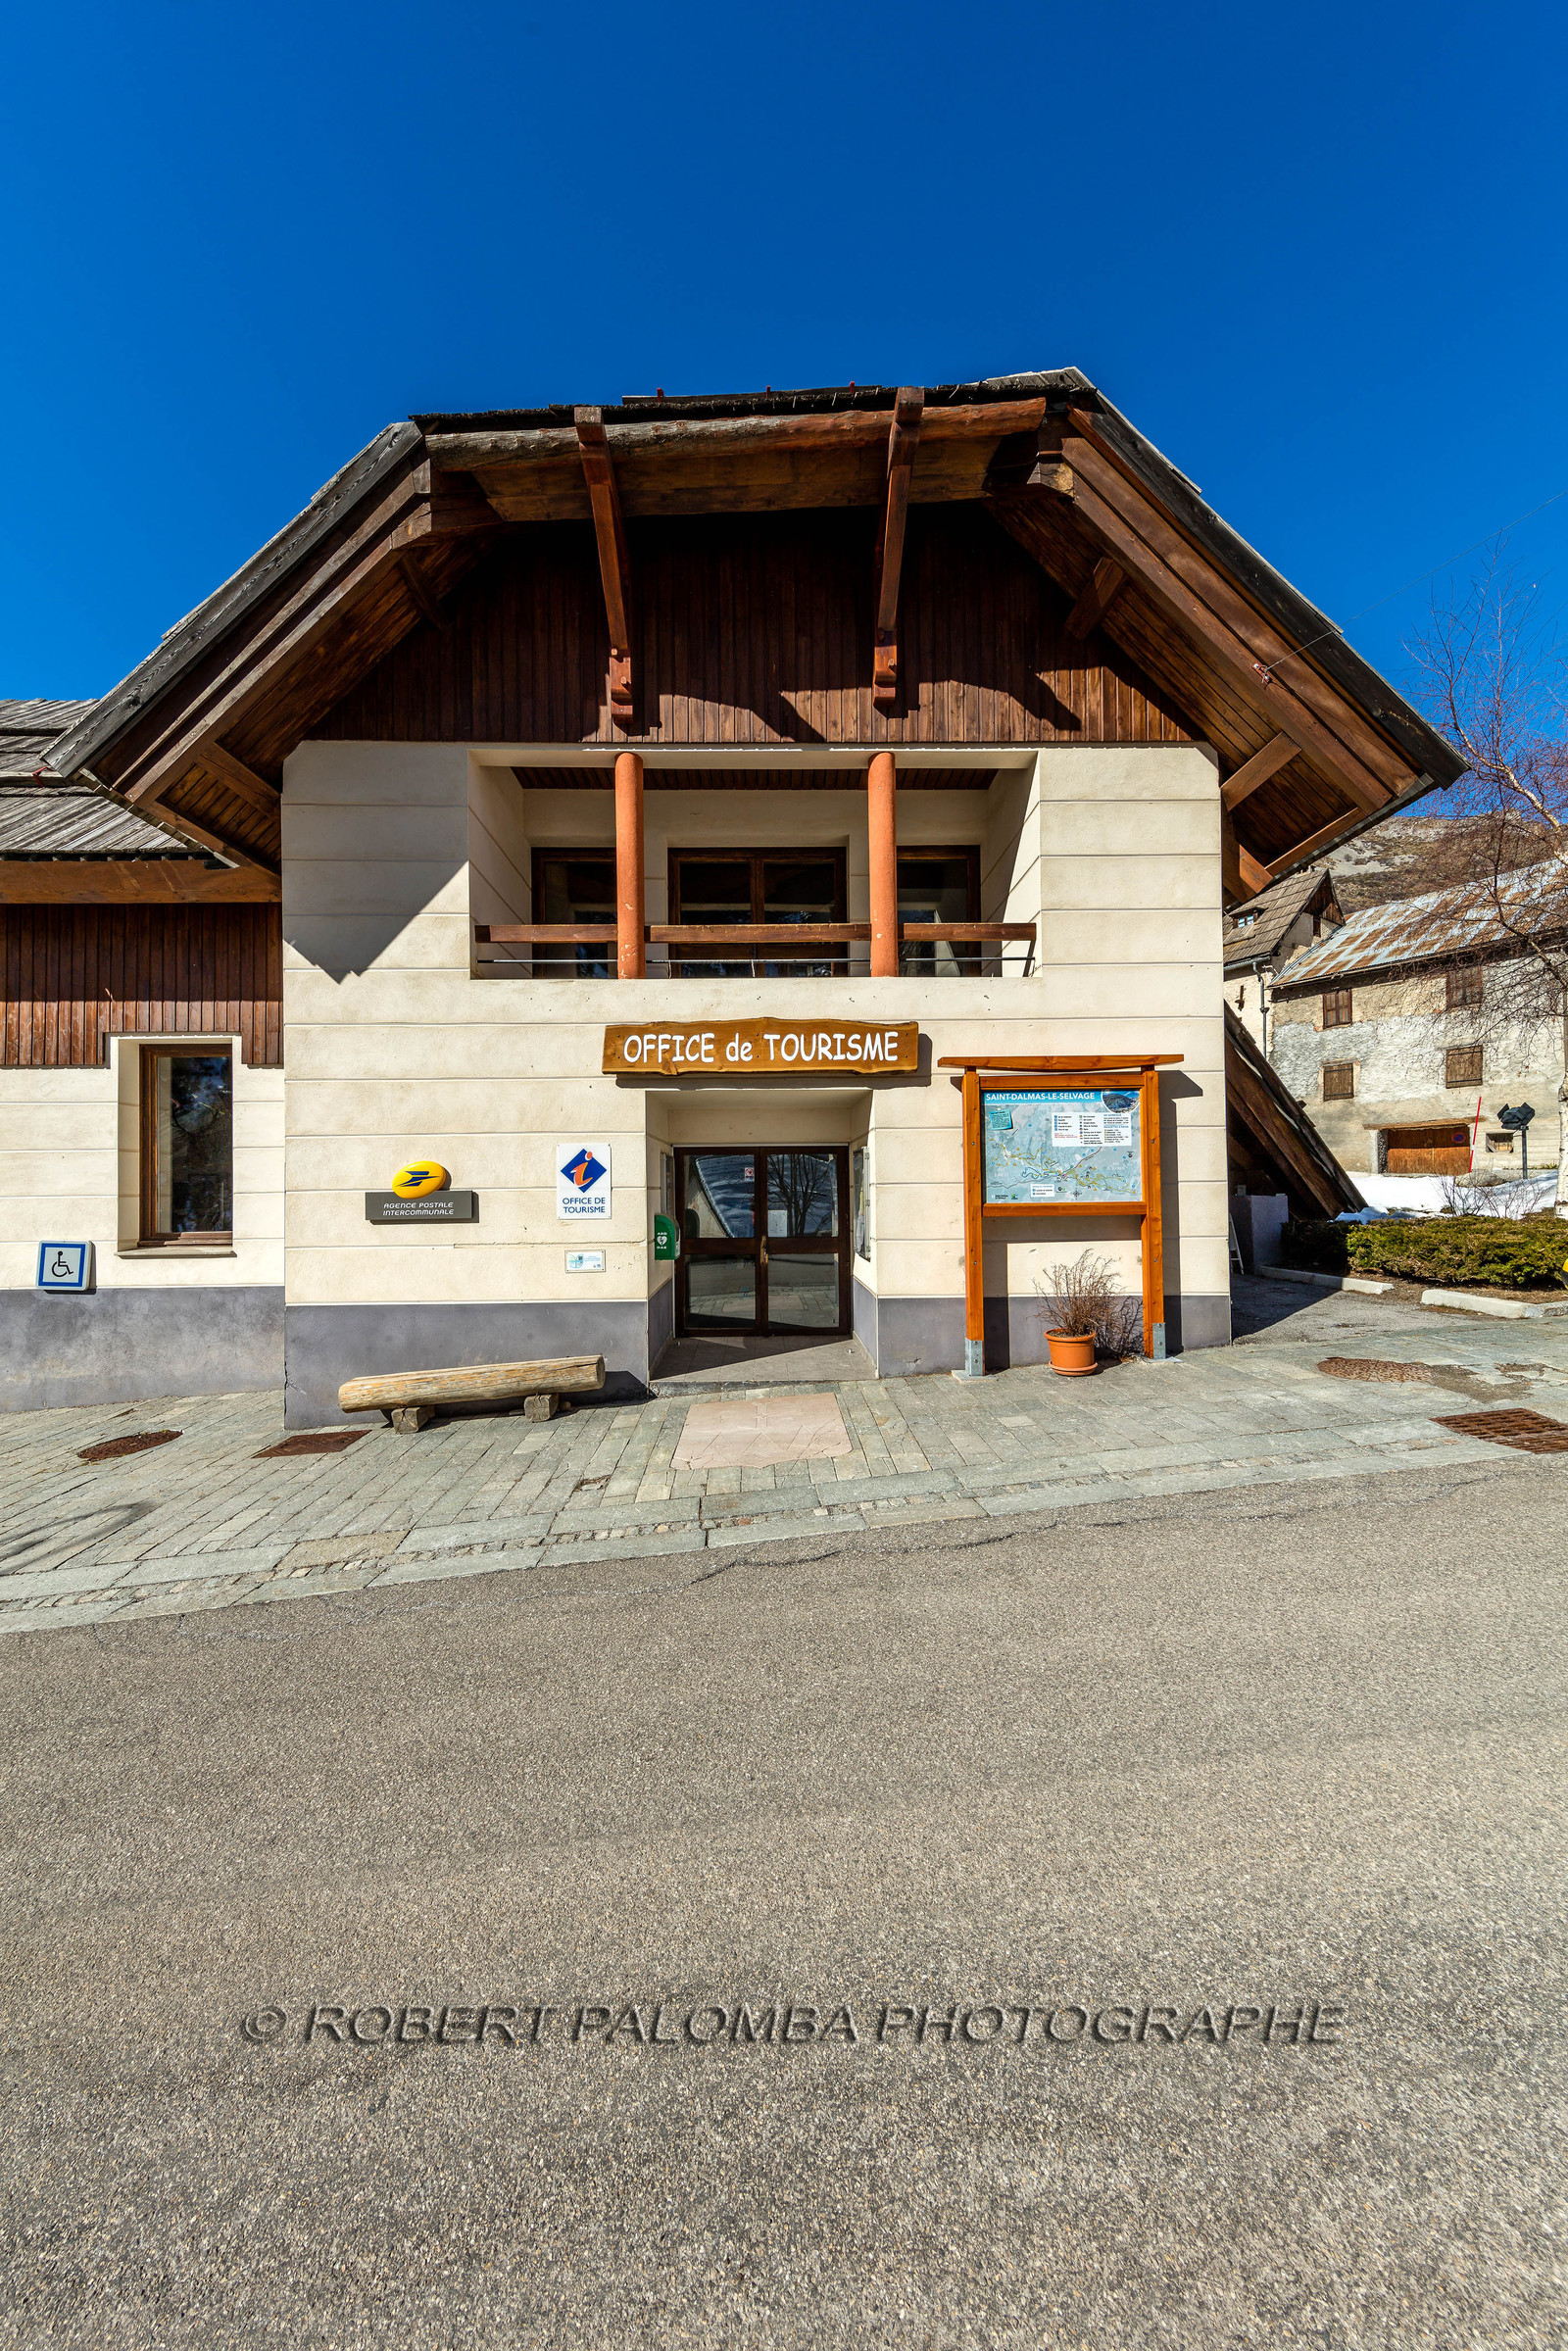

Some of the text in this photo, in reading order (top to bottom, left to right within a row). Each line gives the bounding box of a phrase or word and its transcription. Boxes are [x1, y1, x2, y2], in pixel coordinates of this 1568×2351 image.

[623, 1031, 899, 1062] OFFICE de TOURISME
[986, 1092, 1096, 1101] SAINT-DALMAS-LE-SELVAGE
[564, 1205, 606, 1214] TOURISME
